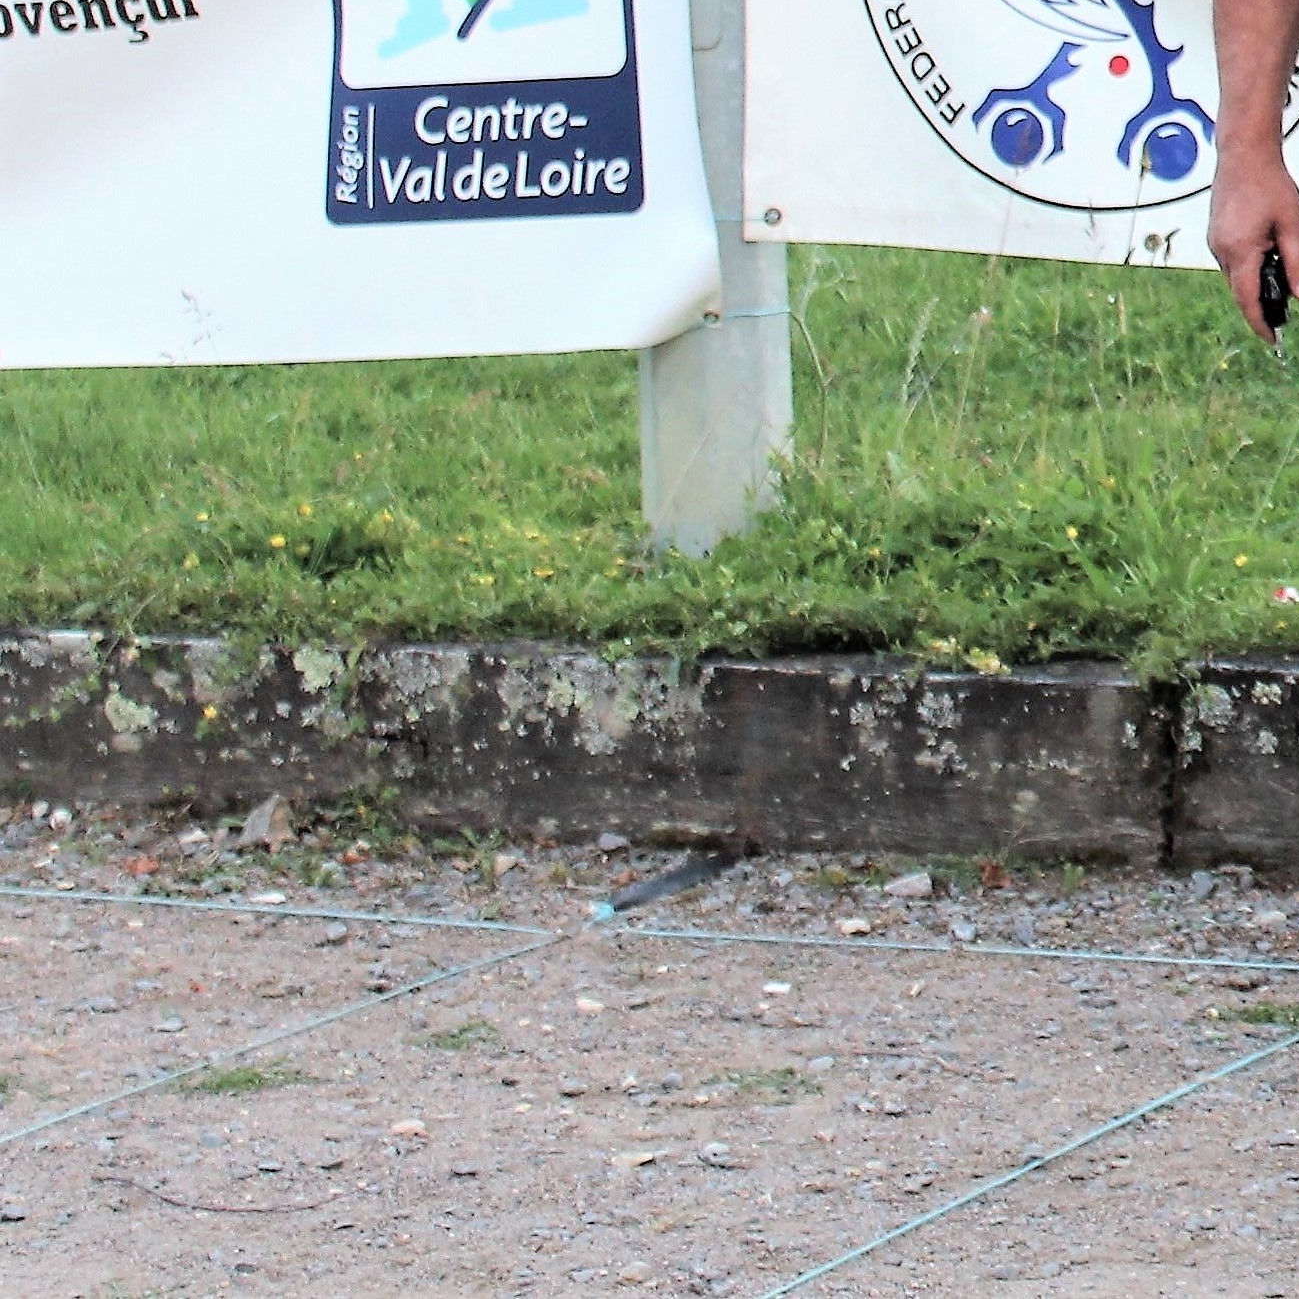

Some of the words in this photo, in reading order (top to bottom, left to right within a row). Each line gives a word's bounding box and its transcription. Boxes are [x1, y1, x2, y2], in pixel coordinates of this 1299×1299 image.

[414, 95, 589, 145] Centre-
[335, 104, 365, 205] Région
[378, 149, 448, 204] Val
[452, 147, 511, 202] de
[514, 147, 632, 199] Loire
